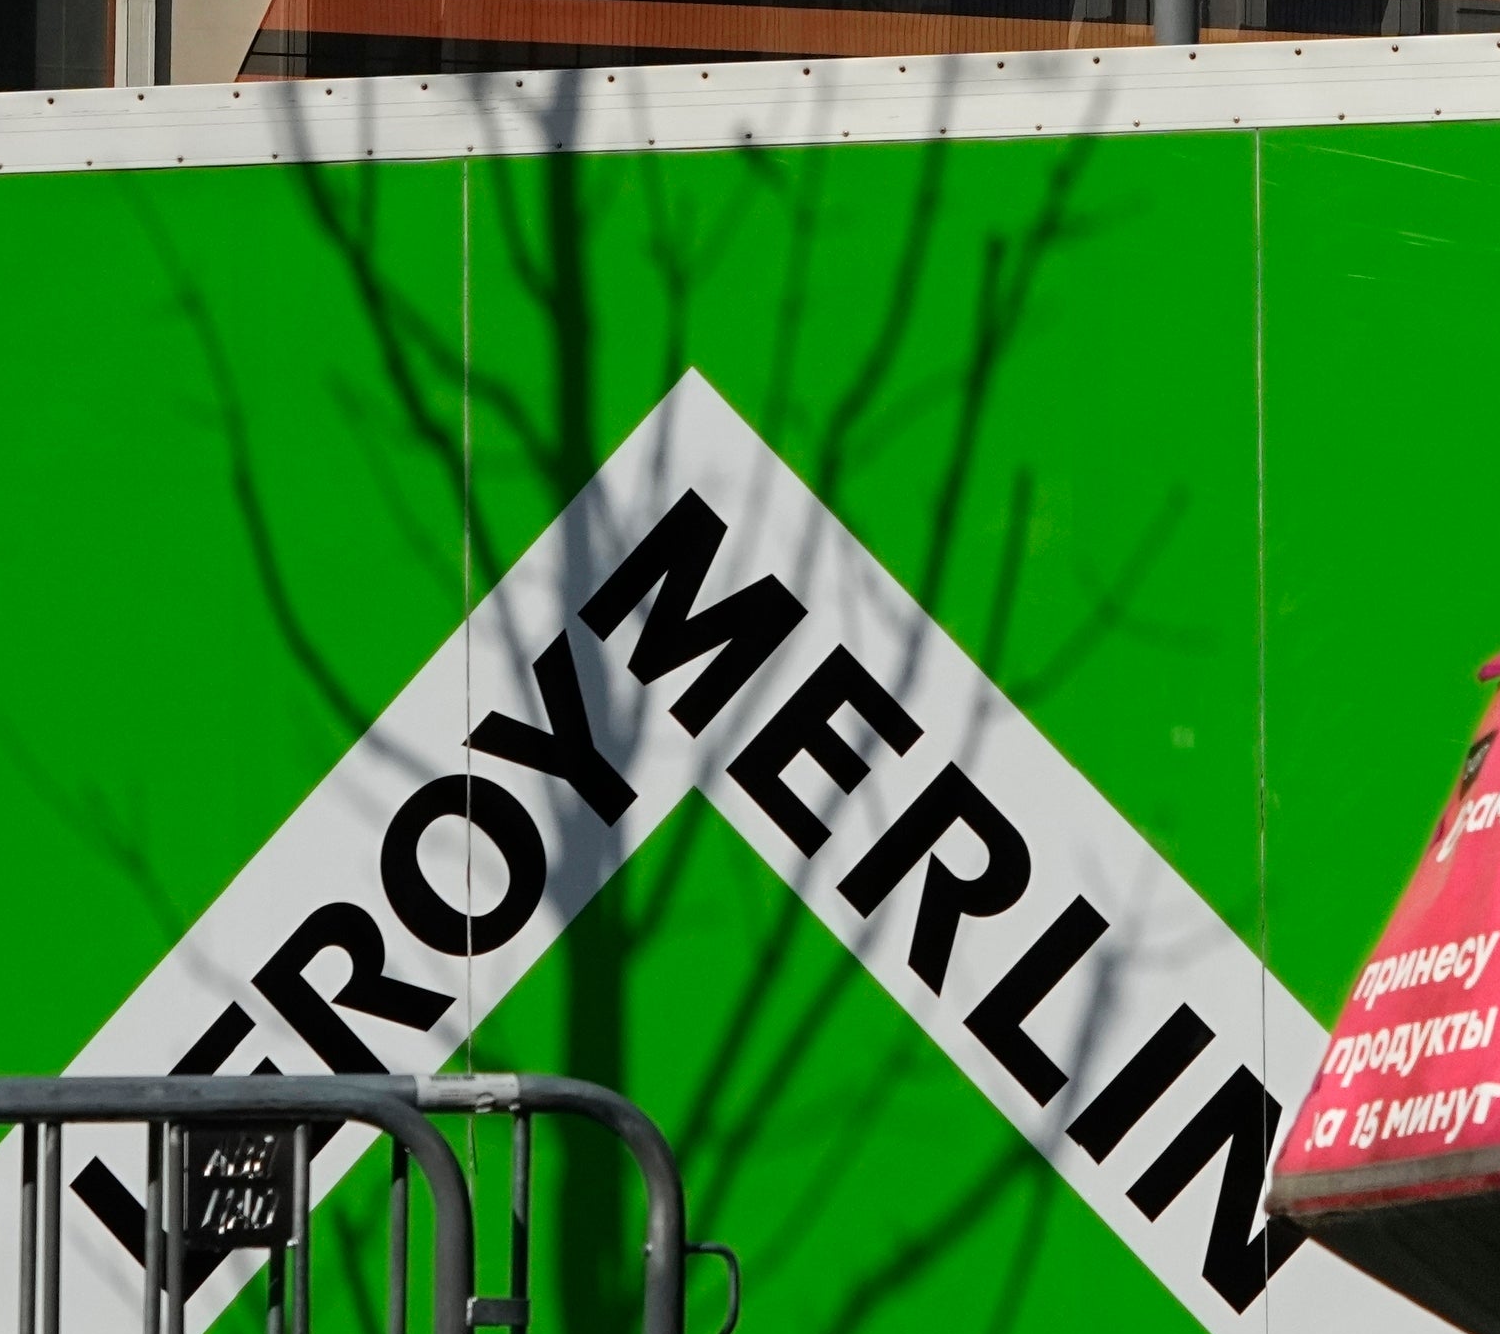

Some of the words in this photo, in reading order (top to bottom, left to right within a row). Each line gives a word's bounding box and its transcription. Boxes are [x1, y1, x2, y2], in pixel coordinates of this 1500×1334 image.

[579, 486, 1308, 1316] MERLIN
[1352, 930, 1500, 1002] принесу
[1322, 1004, 1496, 1088] продукты
[1350, 1101, 1385, 1151] 15
